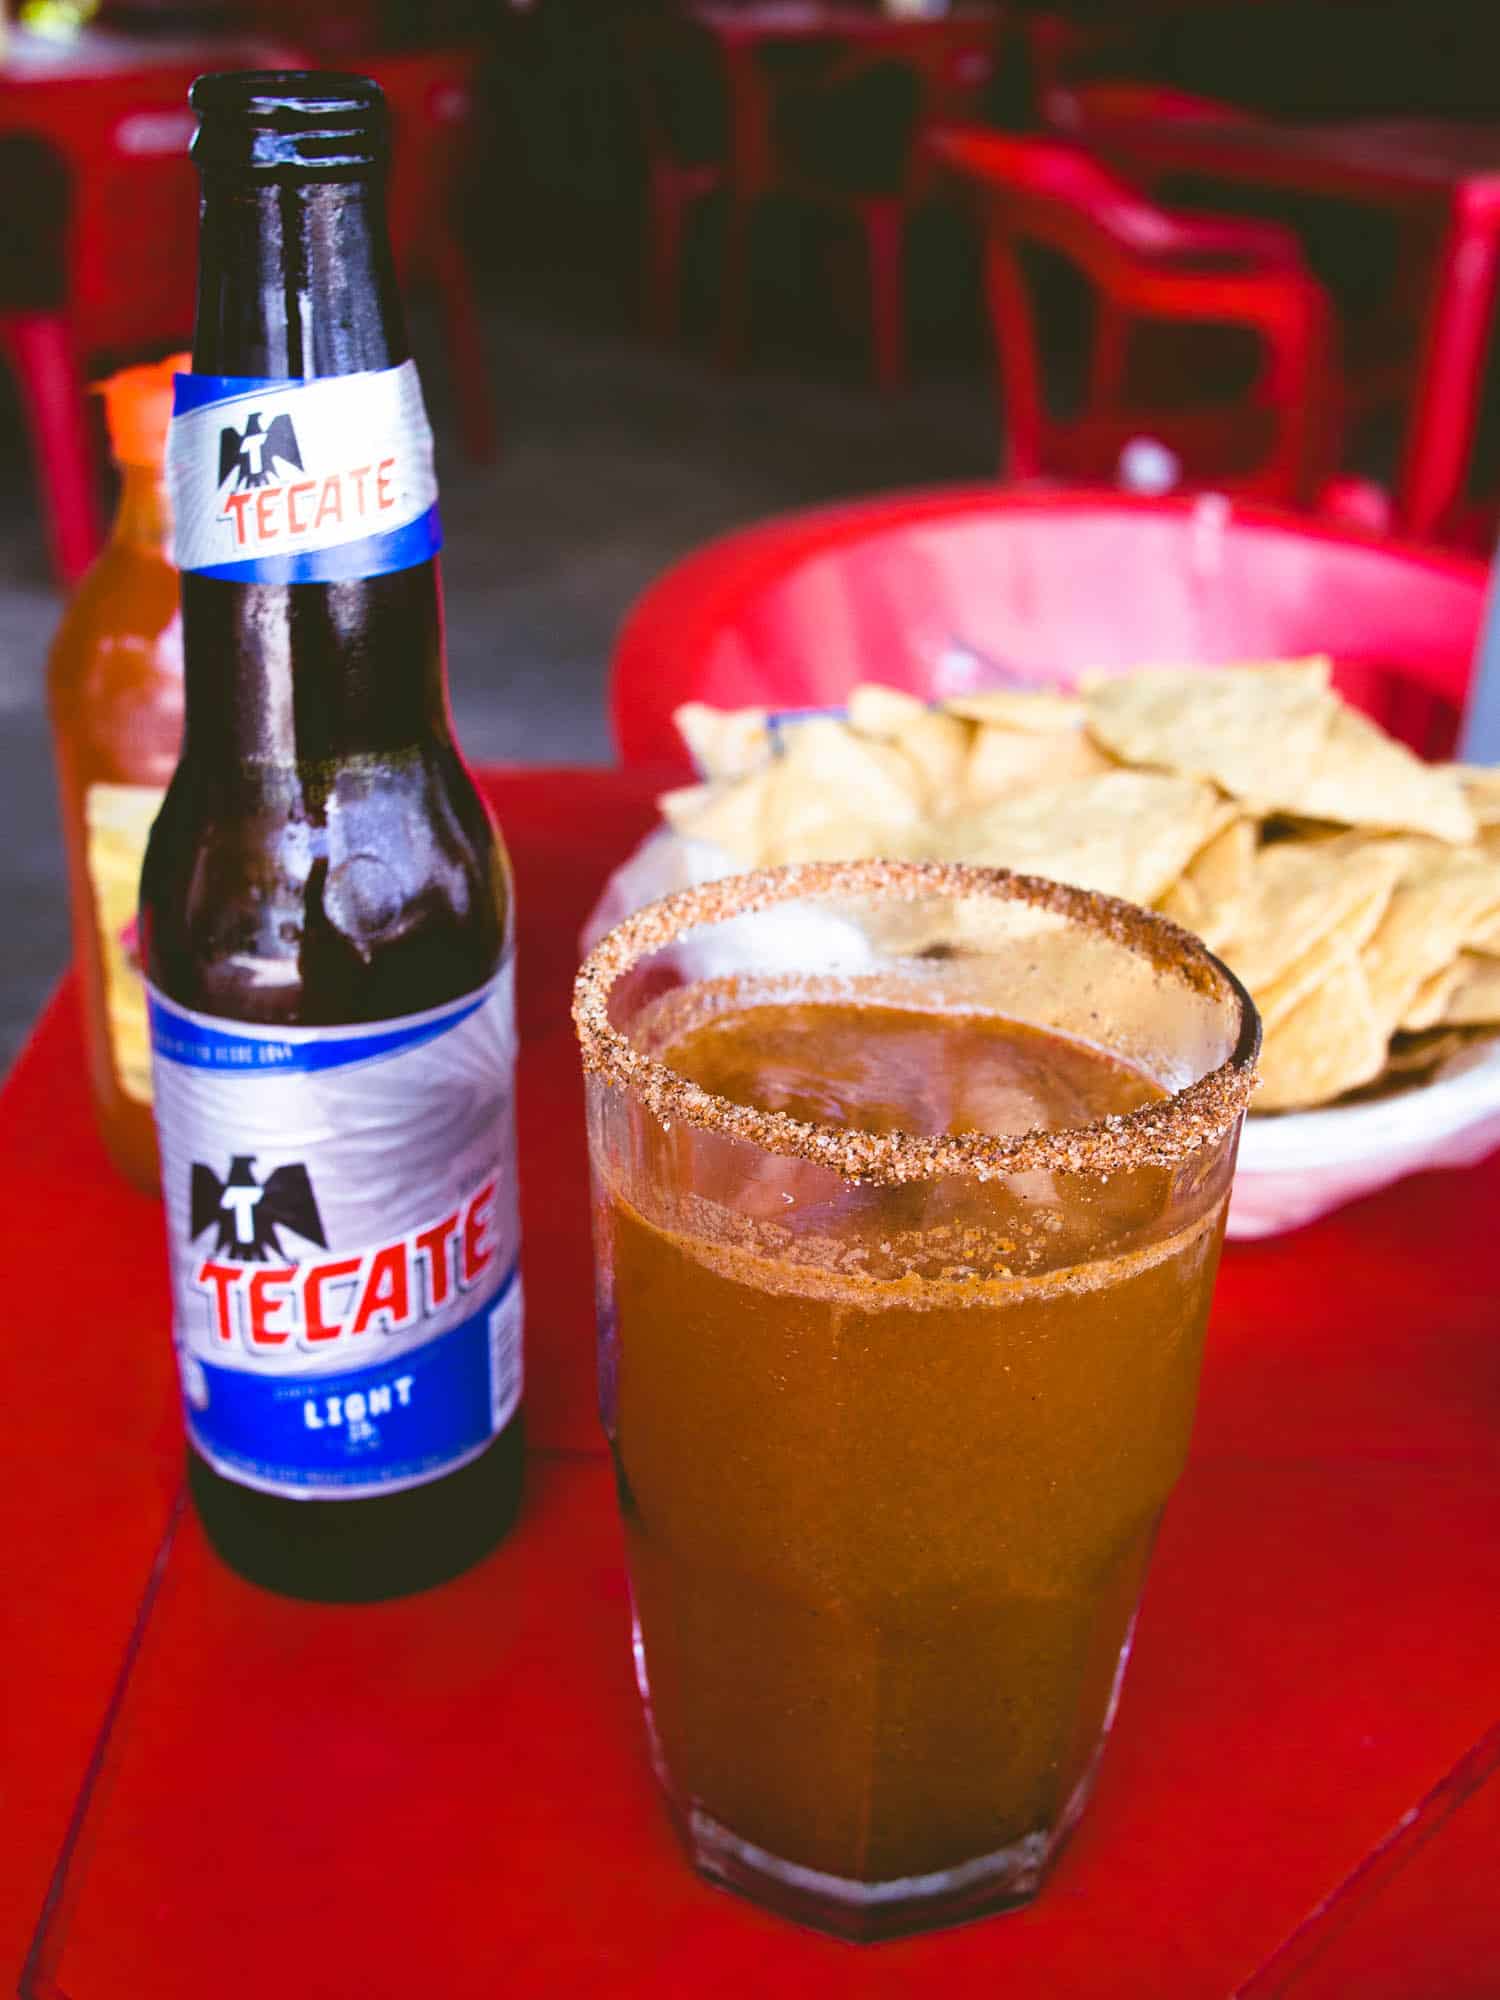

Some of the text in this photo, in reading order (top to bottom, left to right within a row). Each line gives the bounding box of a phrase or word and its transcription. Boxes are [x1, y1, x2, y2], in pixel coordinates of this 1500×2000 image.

[224, 458, 395, 544] TECATE
[220, 1187, 263, 1243] T
[200, 1183, 496, 1344] TECATE
[303, 1374, 414, 1430] LIGHT
